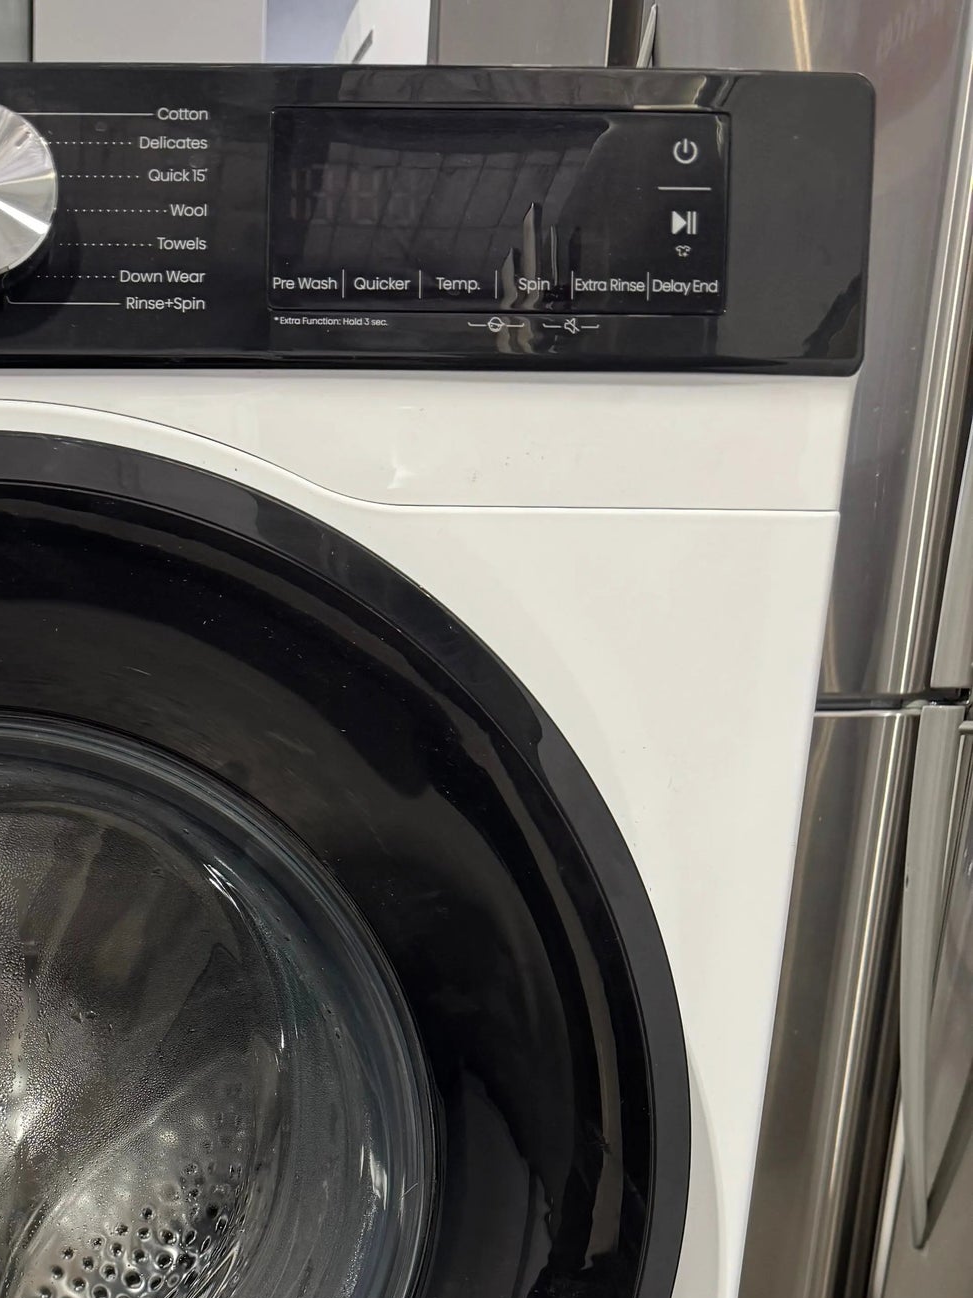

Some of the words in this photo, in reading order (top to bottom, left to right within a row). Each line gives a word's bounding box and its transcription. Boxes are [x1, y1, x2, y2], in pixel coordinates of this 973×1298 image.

[156, 107, 209, 121] Cotton
[138, 136, 208, 150] Delicates
[148, 168, 190, 183] Quick
[170, 204, 208, 217] Wool
[157, 236, 207, 251] Towels
[119, 269, 163, 283] Down
[165, 269, 206, 283] Wear
[272, 276, 295, 290] Pre
[298, 276, 338, 290] Wash
[353, 276, 411, 291] Quicker
[436, 276, 481, 293] Temp.
[518, 277, 550, 294] Spin
[575, 278, 607, 292] Extra
[610, 278, 645, 292] Rinse
[652, 279, 691, 296] Delay
[692, 279, 719, 293] End
[125, 296, 206, 313] Rinse+Spin
[302, 316, 342, 326] Function:
[342, 317, 363, 326] Hold
[364, 318, 370, 326] 3
[371, 318, 388, 326] sec.
